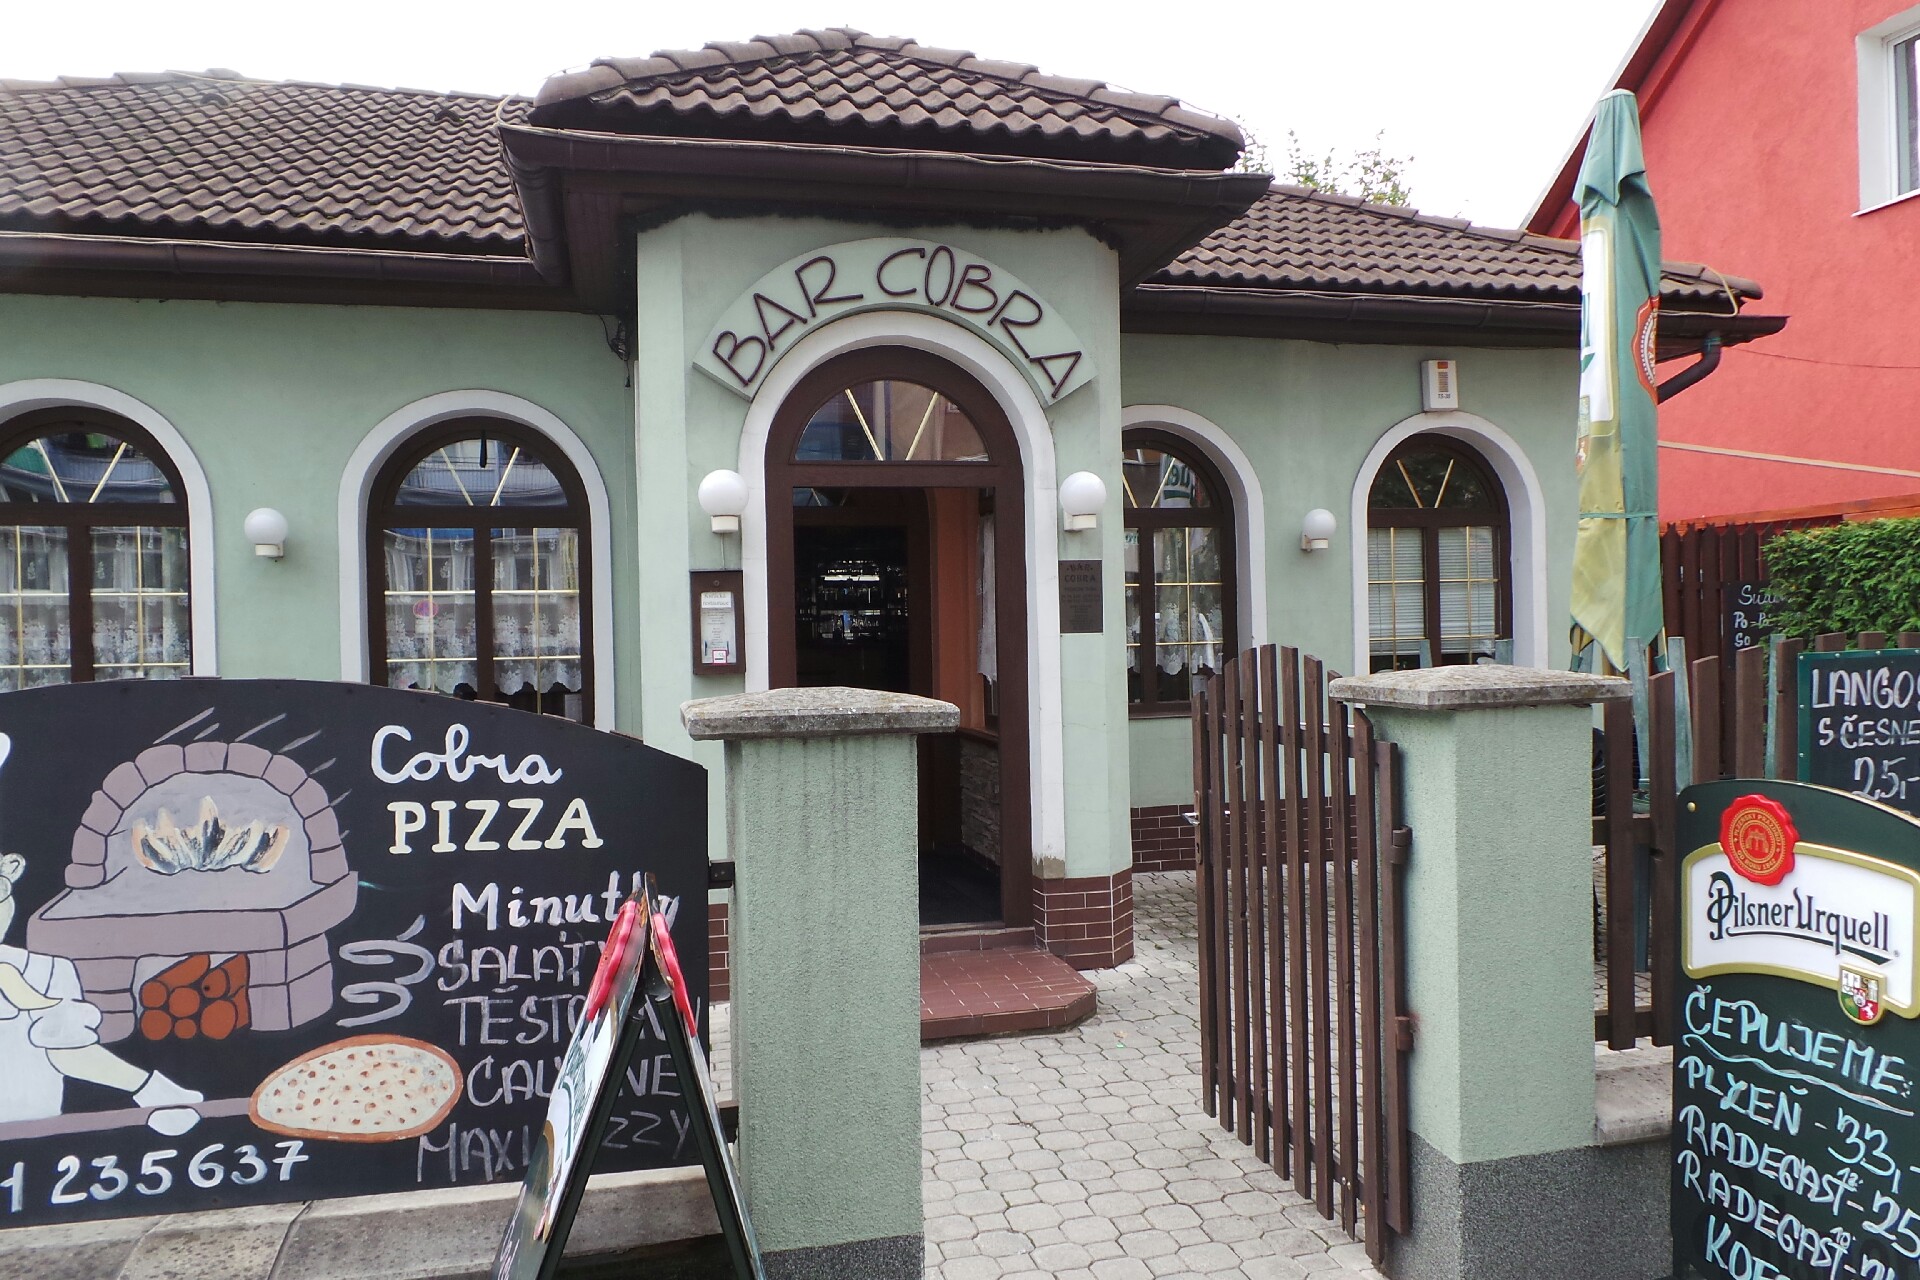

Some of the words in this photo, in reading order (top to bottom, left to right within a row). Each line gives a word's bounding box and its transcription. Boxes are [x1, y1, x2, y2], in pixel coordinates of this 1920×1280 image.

[712, 254, 864, 386] BAR
[876, 244, 1083, 398] COBRA
[1812, 666, 1920, 711] LANGO
[371, 723, 563, 784] Cobra
[1818, 717, 1835, 746] S
[386, 797, 604, 855] PIZZA
[1706, 870, 1796, 941] Pilsner
[1793, 886, 1890, 956] Urquell
[1683, 984, 1914, 1099] ČEPUJEME:
[1678, 1055, 1809, 1136] PLZEŇ
[416, 1121, 529, 1182] MAXI
[1678, 1104, 1858, 1216] RADEGAST
[1677, 1149, 1850, 1280] RADEGAST
